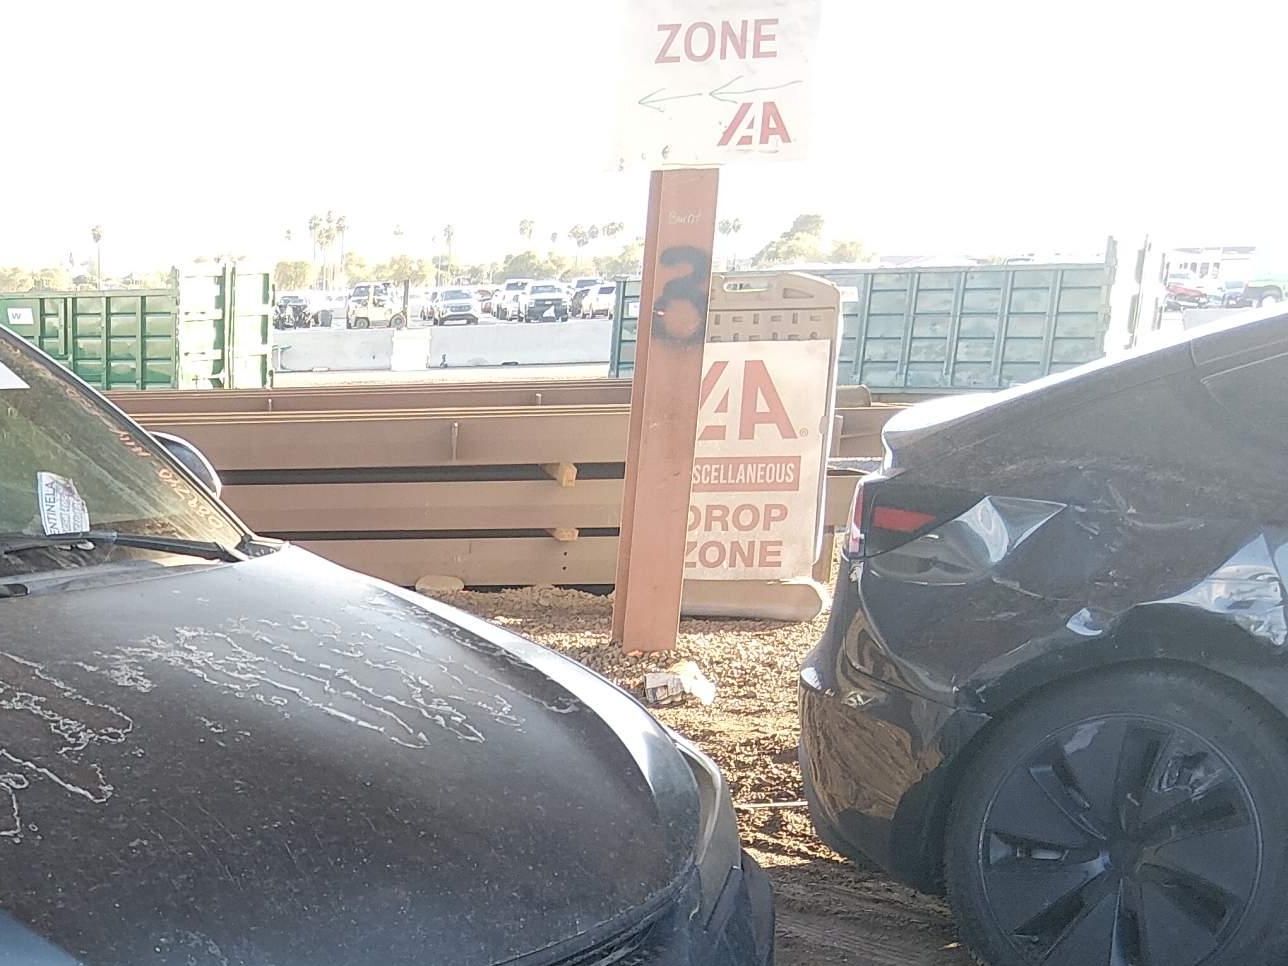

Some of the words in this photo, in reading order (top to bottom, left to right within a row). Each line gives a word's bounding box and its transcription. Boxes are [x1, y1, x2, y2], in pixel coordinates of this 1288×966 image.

[655, 18, 779, 64] ZONE
[692, 462, 795, 485] SCELLANEOUS
[44, 480, 59, 534] ENTINELA
